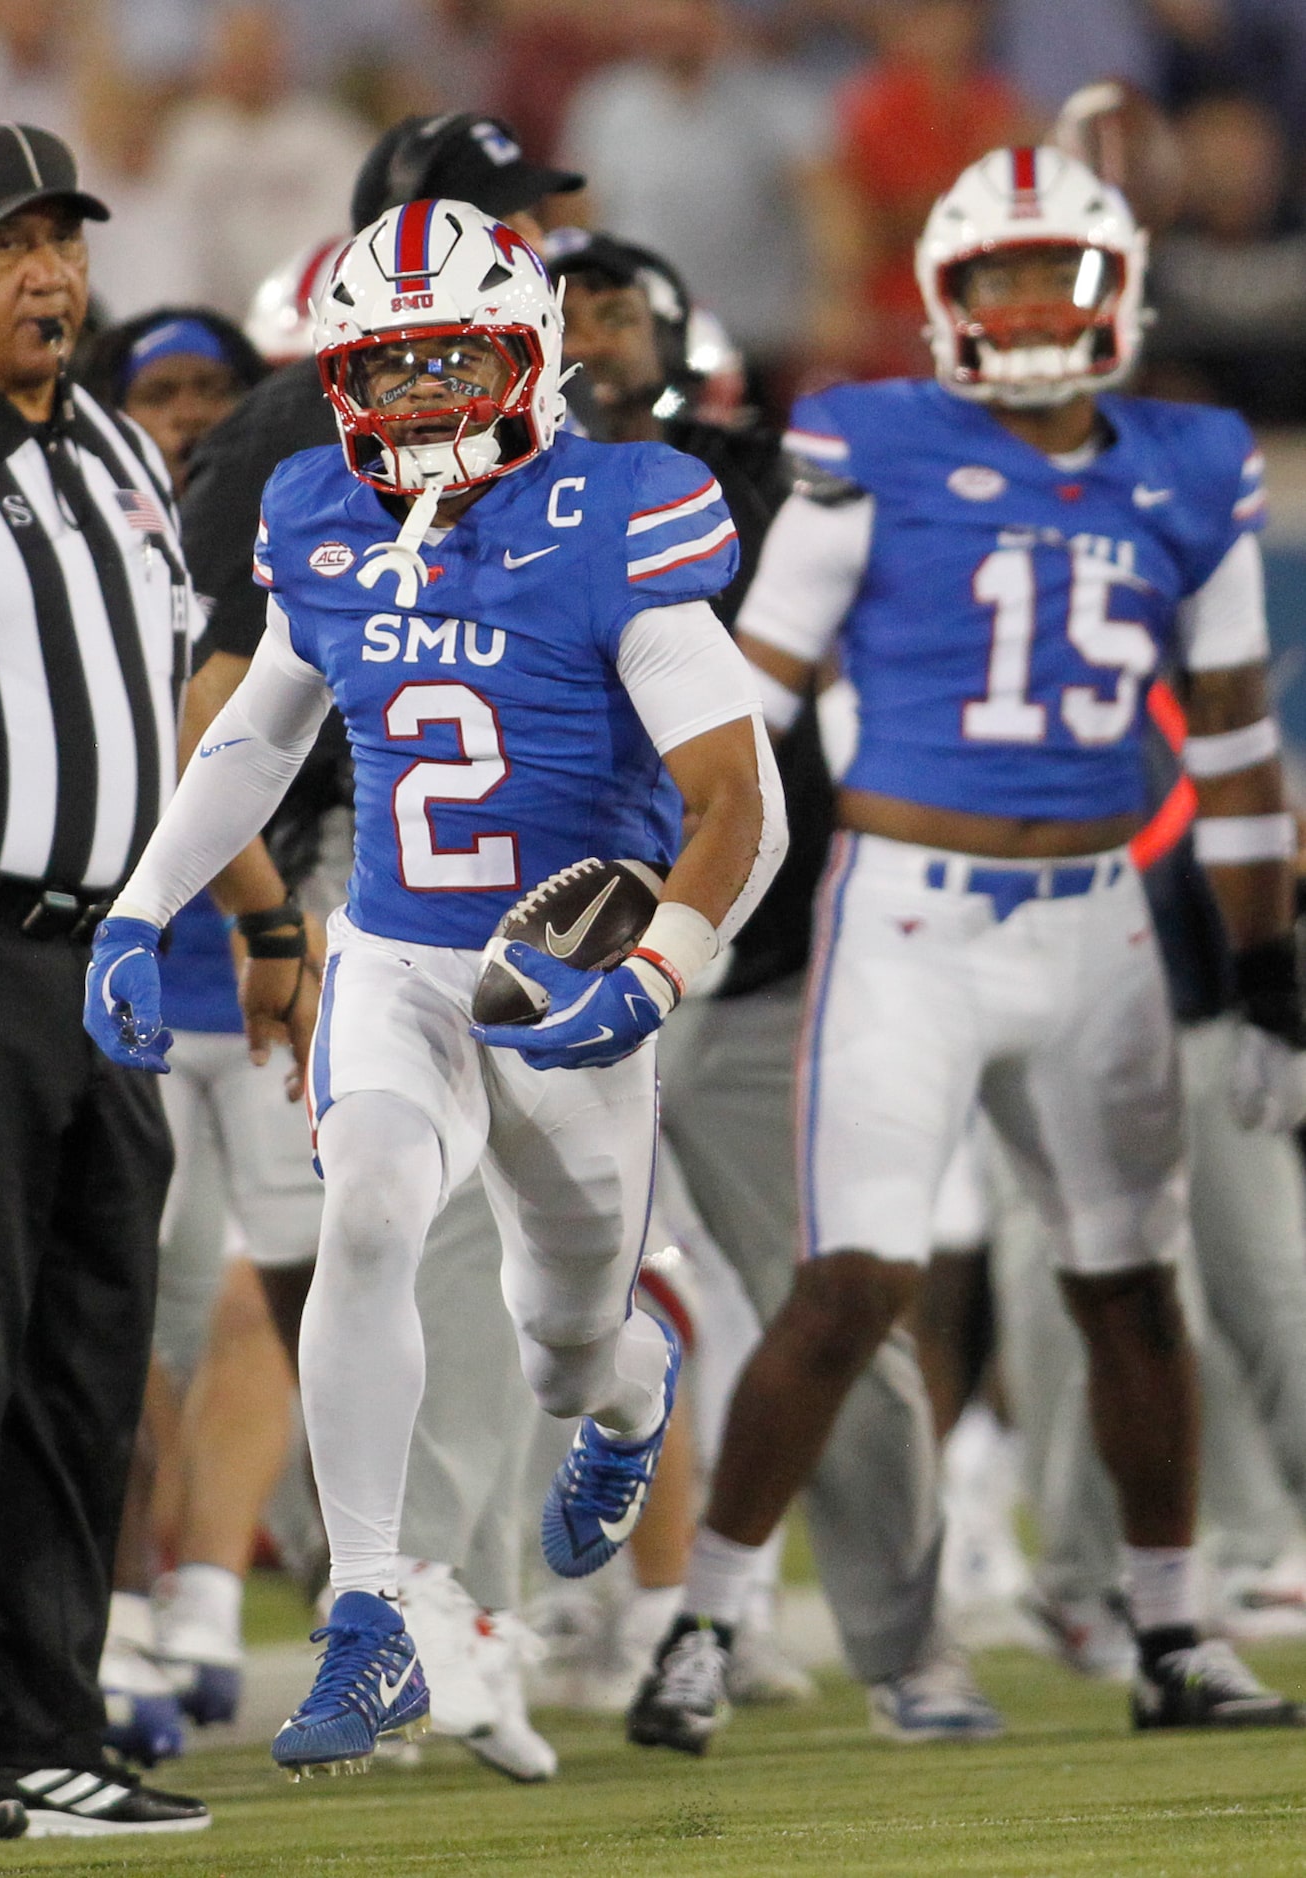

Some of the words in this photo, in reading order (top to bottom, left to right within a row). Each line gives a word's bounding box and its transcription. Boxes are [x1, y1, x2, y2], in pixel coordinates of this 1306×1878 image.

[390, 293, 434, 312] SMU
[381, 372, 420, 405] ROMAN
[2, 494, 32, 527] S
[547, 476, 586, 528] C
[315, 550, 348, 564] ACC
[362, 612, 506, 667] SMU
[961, 547, 1159, 746] 15
[382, 679, 522, 893] 2
